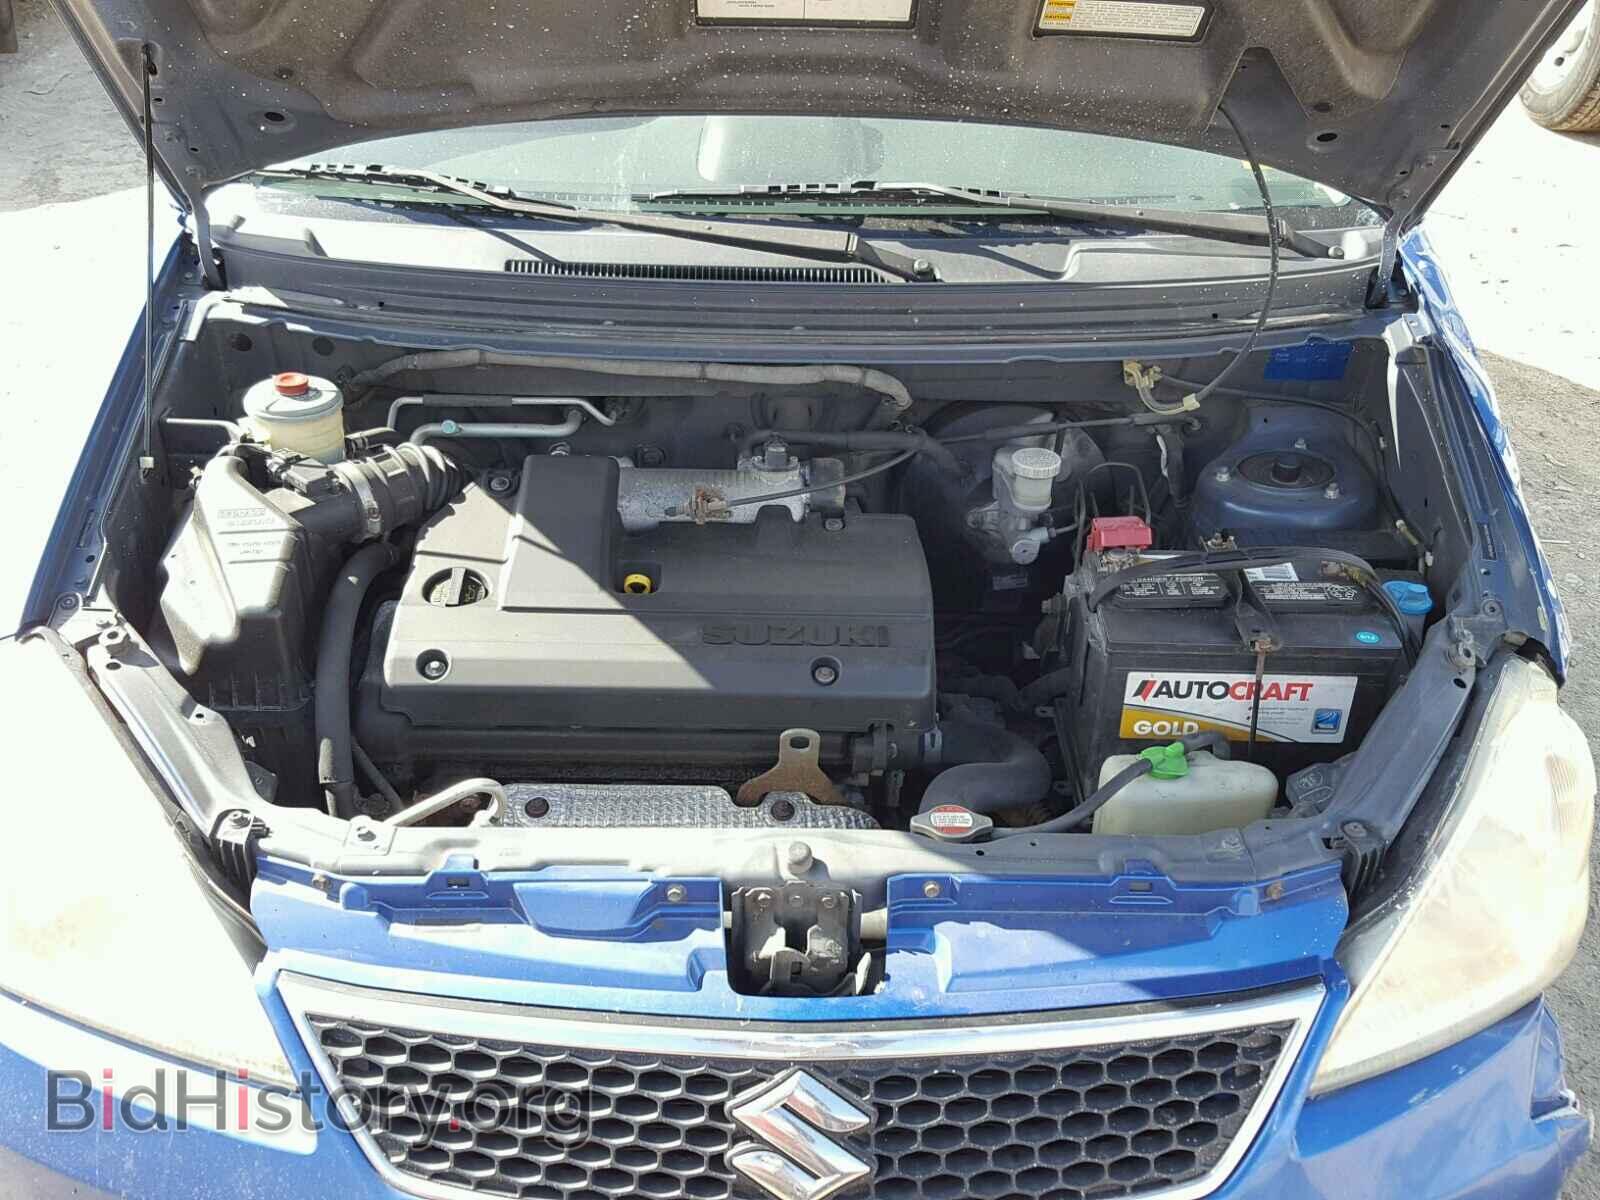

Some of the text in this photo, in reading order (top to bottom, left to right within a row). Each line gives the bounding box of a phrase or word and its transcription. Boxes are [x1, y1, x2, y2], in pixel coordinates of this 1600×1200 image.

[701, 624, 889, 647] SUZUKI
[1152, 679, 1314, 702] AUTOCRAFT
[1133, 719, 1200, 736] GOLD
